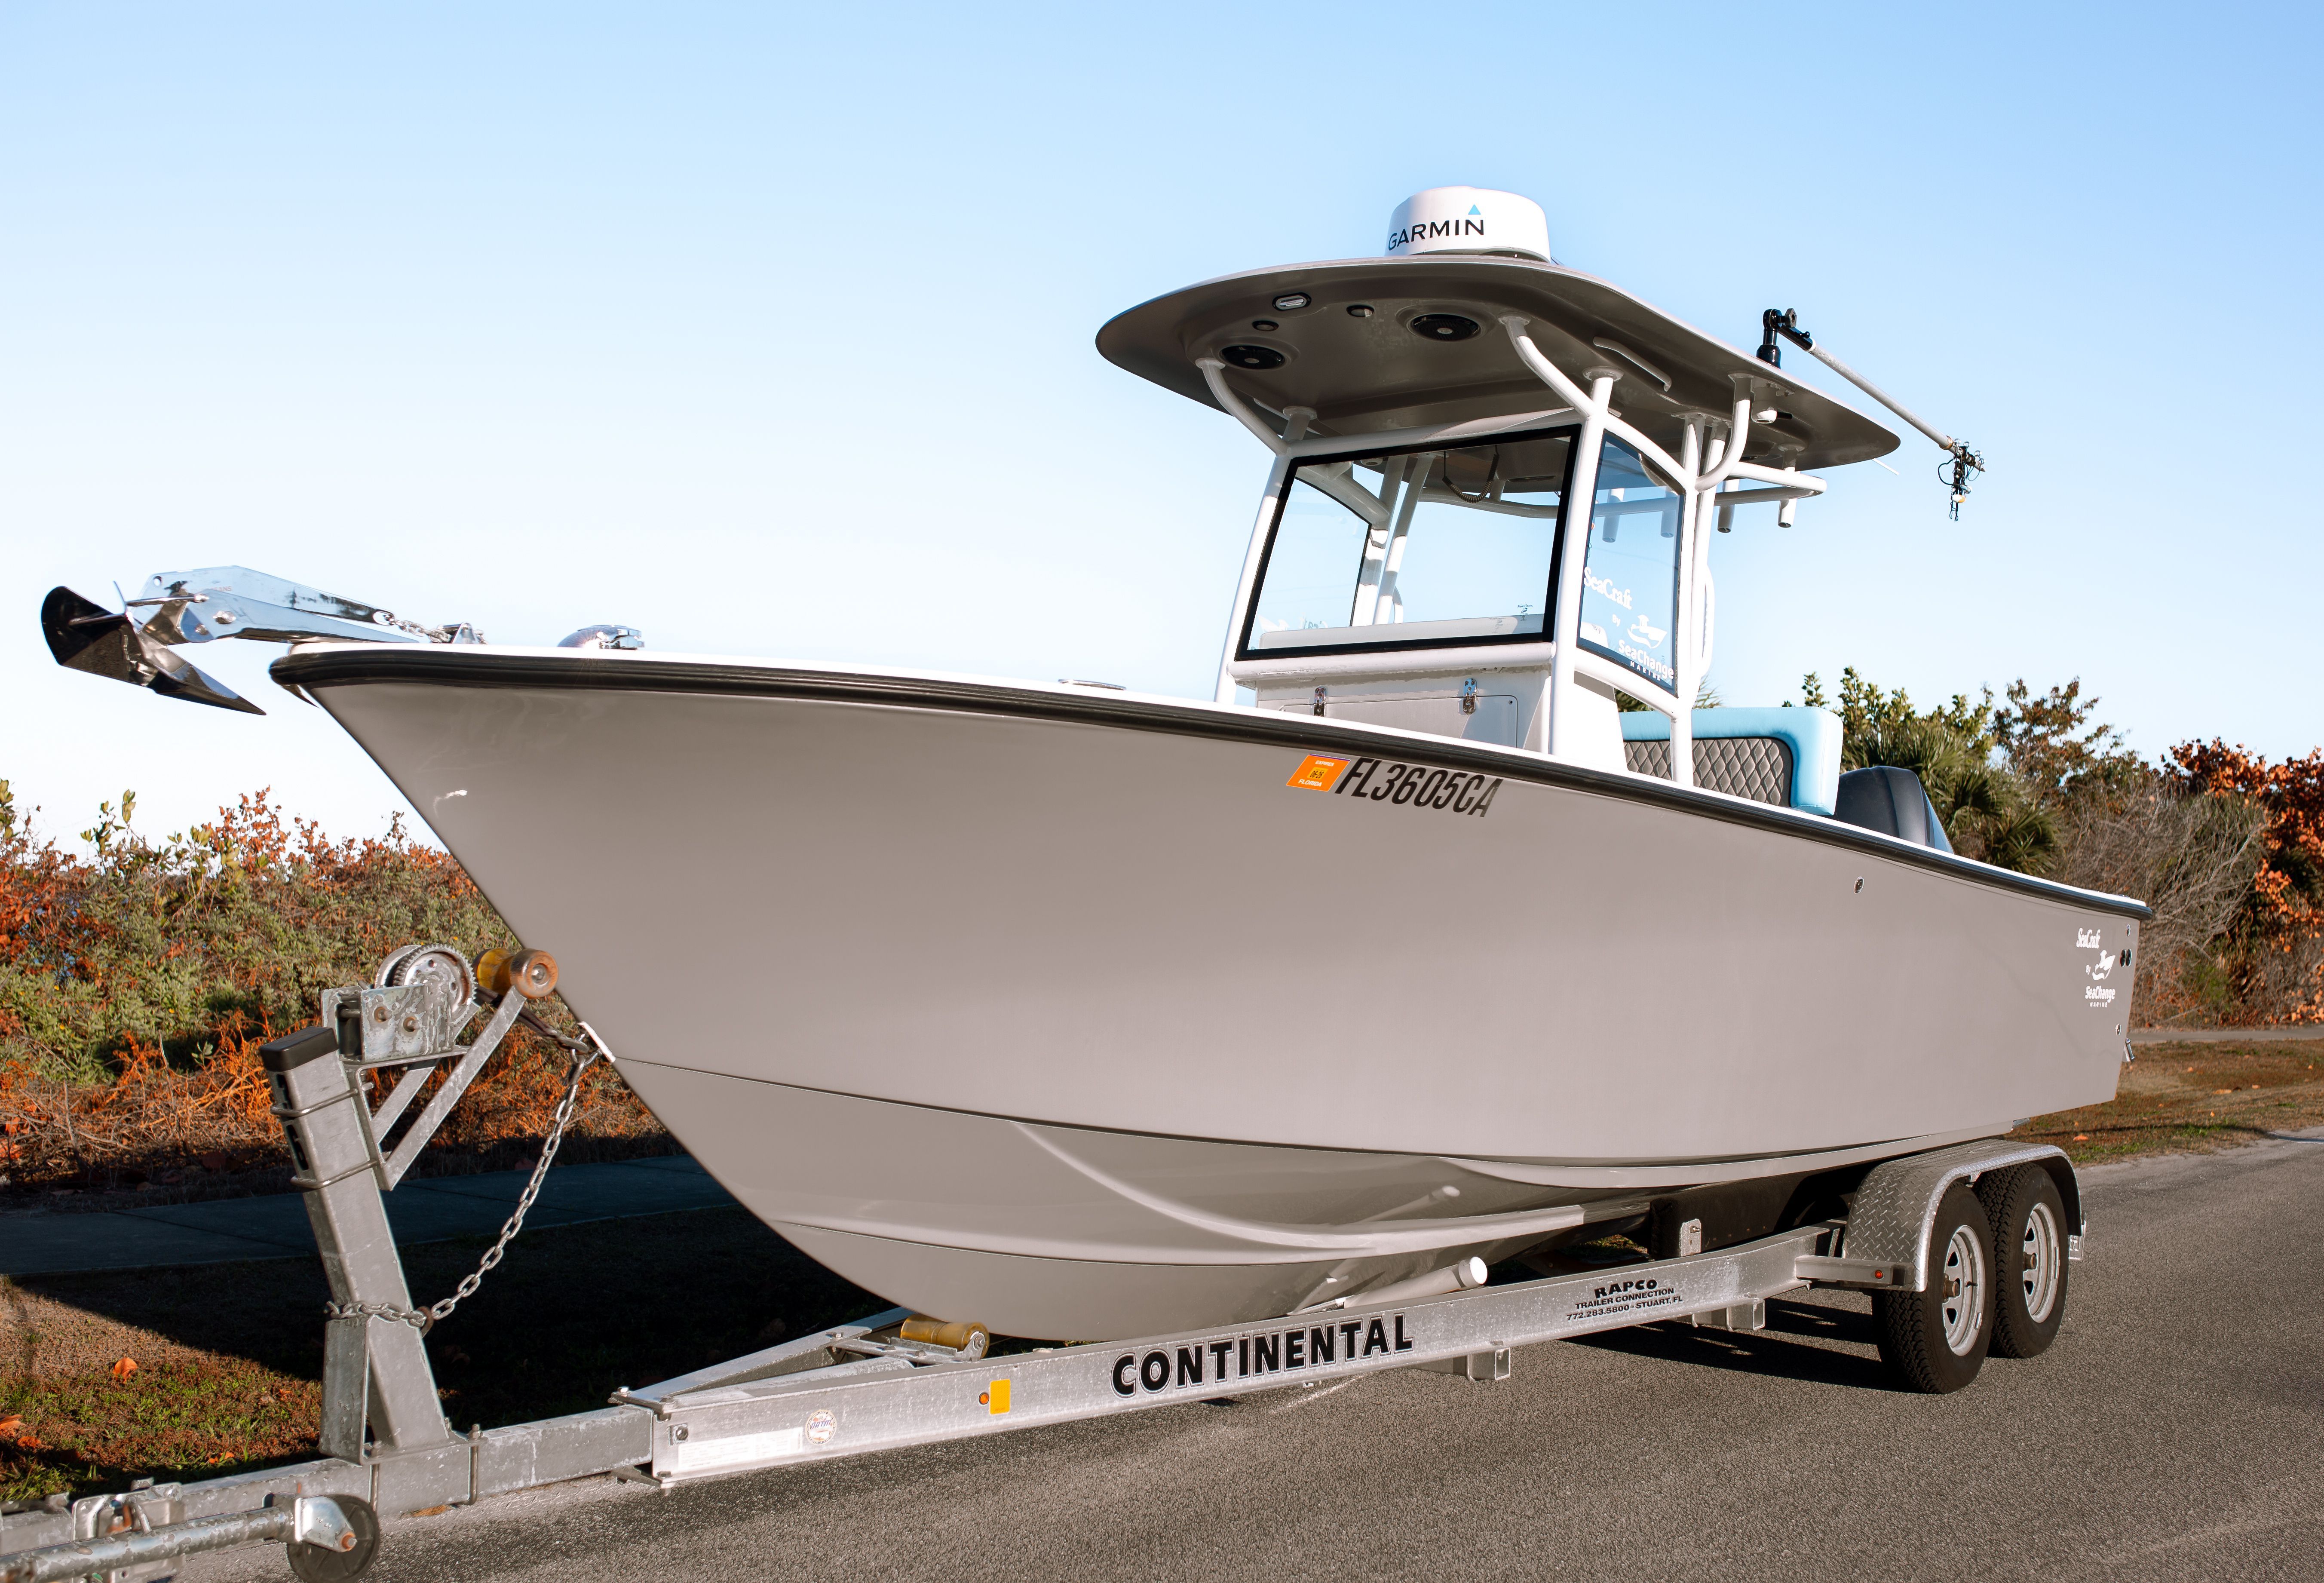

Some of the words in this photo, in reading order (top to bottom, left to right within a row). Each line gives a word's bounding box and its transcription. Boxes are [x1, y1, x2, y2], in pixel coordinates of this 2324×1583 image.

[1388, 219, 1484, 251] GARMIN
[1584, 566, 1633, 610] SeaCraft
[1612, 614, 1621, 627] By
[1618, 639, 1674, 680] SeaChange
[1630, 660, 1661, 681] MARINE
[1298, 779, 1322, 787] FLORIDA
[1334, 757, 1504, 817] FL3605CA
[2076, 928, 2101, 949] SeaCraft
[2085, 985, 2116, 1003] SeaChange
[1575, 1298, 1614, 1310] TRAILER
[1615, 1288, 1674, 1303] CONNECTION
[1594, 1279, 1658, 1299] RAPCO
[1567, 1305, 1630, 1321] 772.283.5800
[1636, 1298, 1671, 1309] STUART,
[1110, 1312, 1415, 1398] CONTINENTAL
